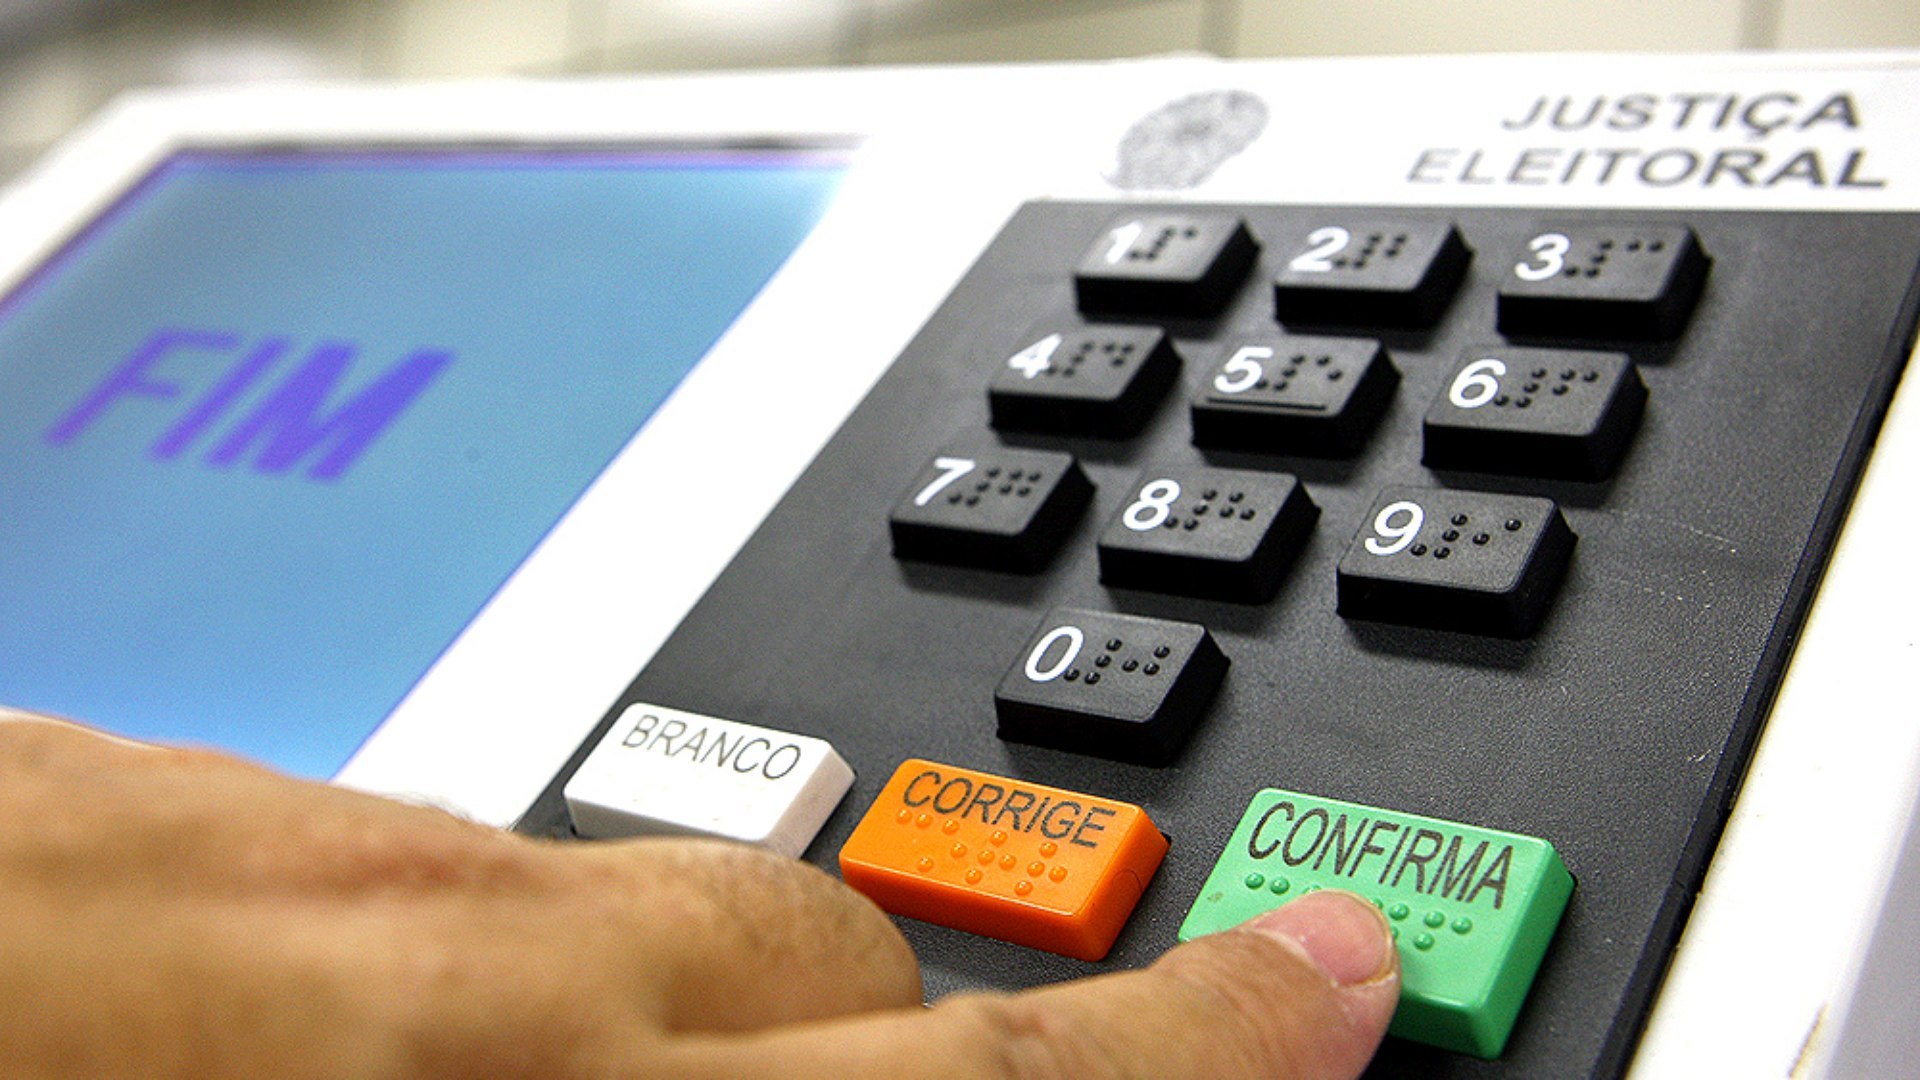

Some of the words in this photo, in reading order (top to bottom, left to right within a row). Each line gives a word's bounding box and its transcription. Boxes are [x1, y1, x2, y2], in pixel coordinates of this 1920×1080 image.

[1501, 91, 1861, 140] JUSTIÇA
[1407, 148, 1886, 188] ELEITORAL
[1103, 224, 1141, 264] 1
[1291, 227, 1350, 271] 2
[1515, 234, 1570, 280] 3
[1008, 334, 1062, 378] 4
[1214, 347, 1274, 392] 5
[45, 328, 457, 483] FIM
[1448, 359, 1506, 408] 6
[914, 457, 975, 505] 7
[1122, 479, 1181, 531] 8
[1364, 502, 1424, 555] 9
[1024, 626, 1083, 681] 0
[621, 714, 802, 780] BRANCO
[903, 771, 1118, 848] CORRIGE
[1248, 801, 1514, 910] CONFIRMA
